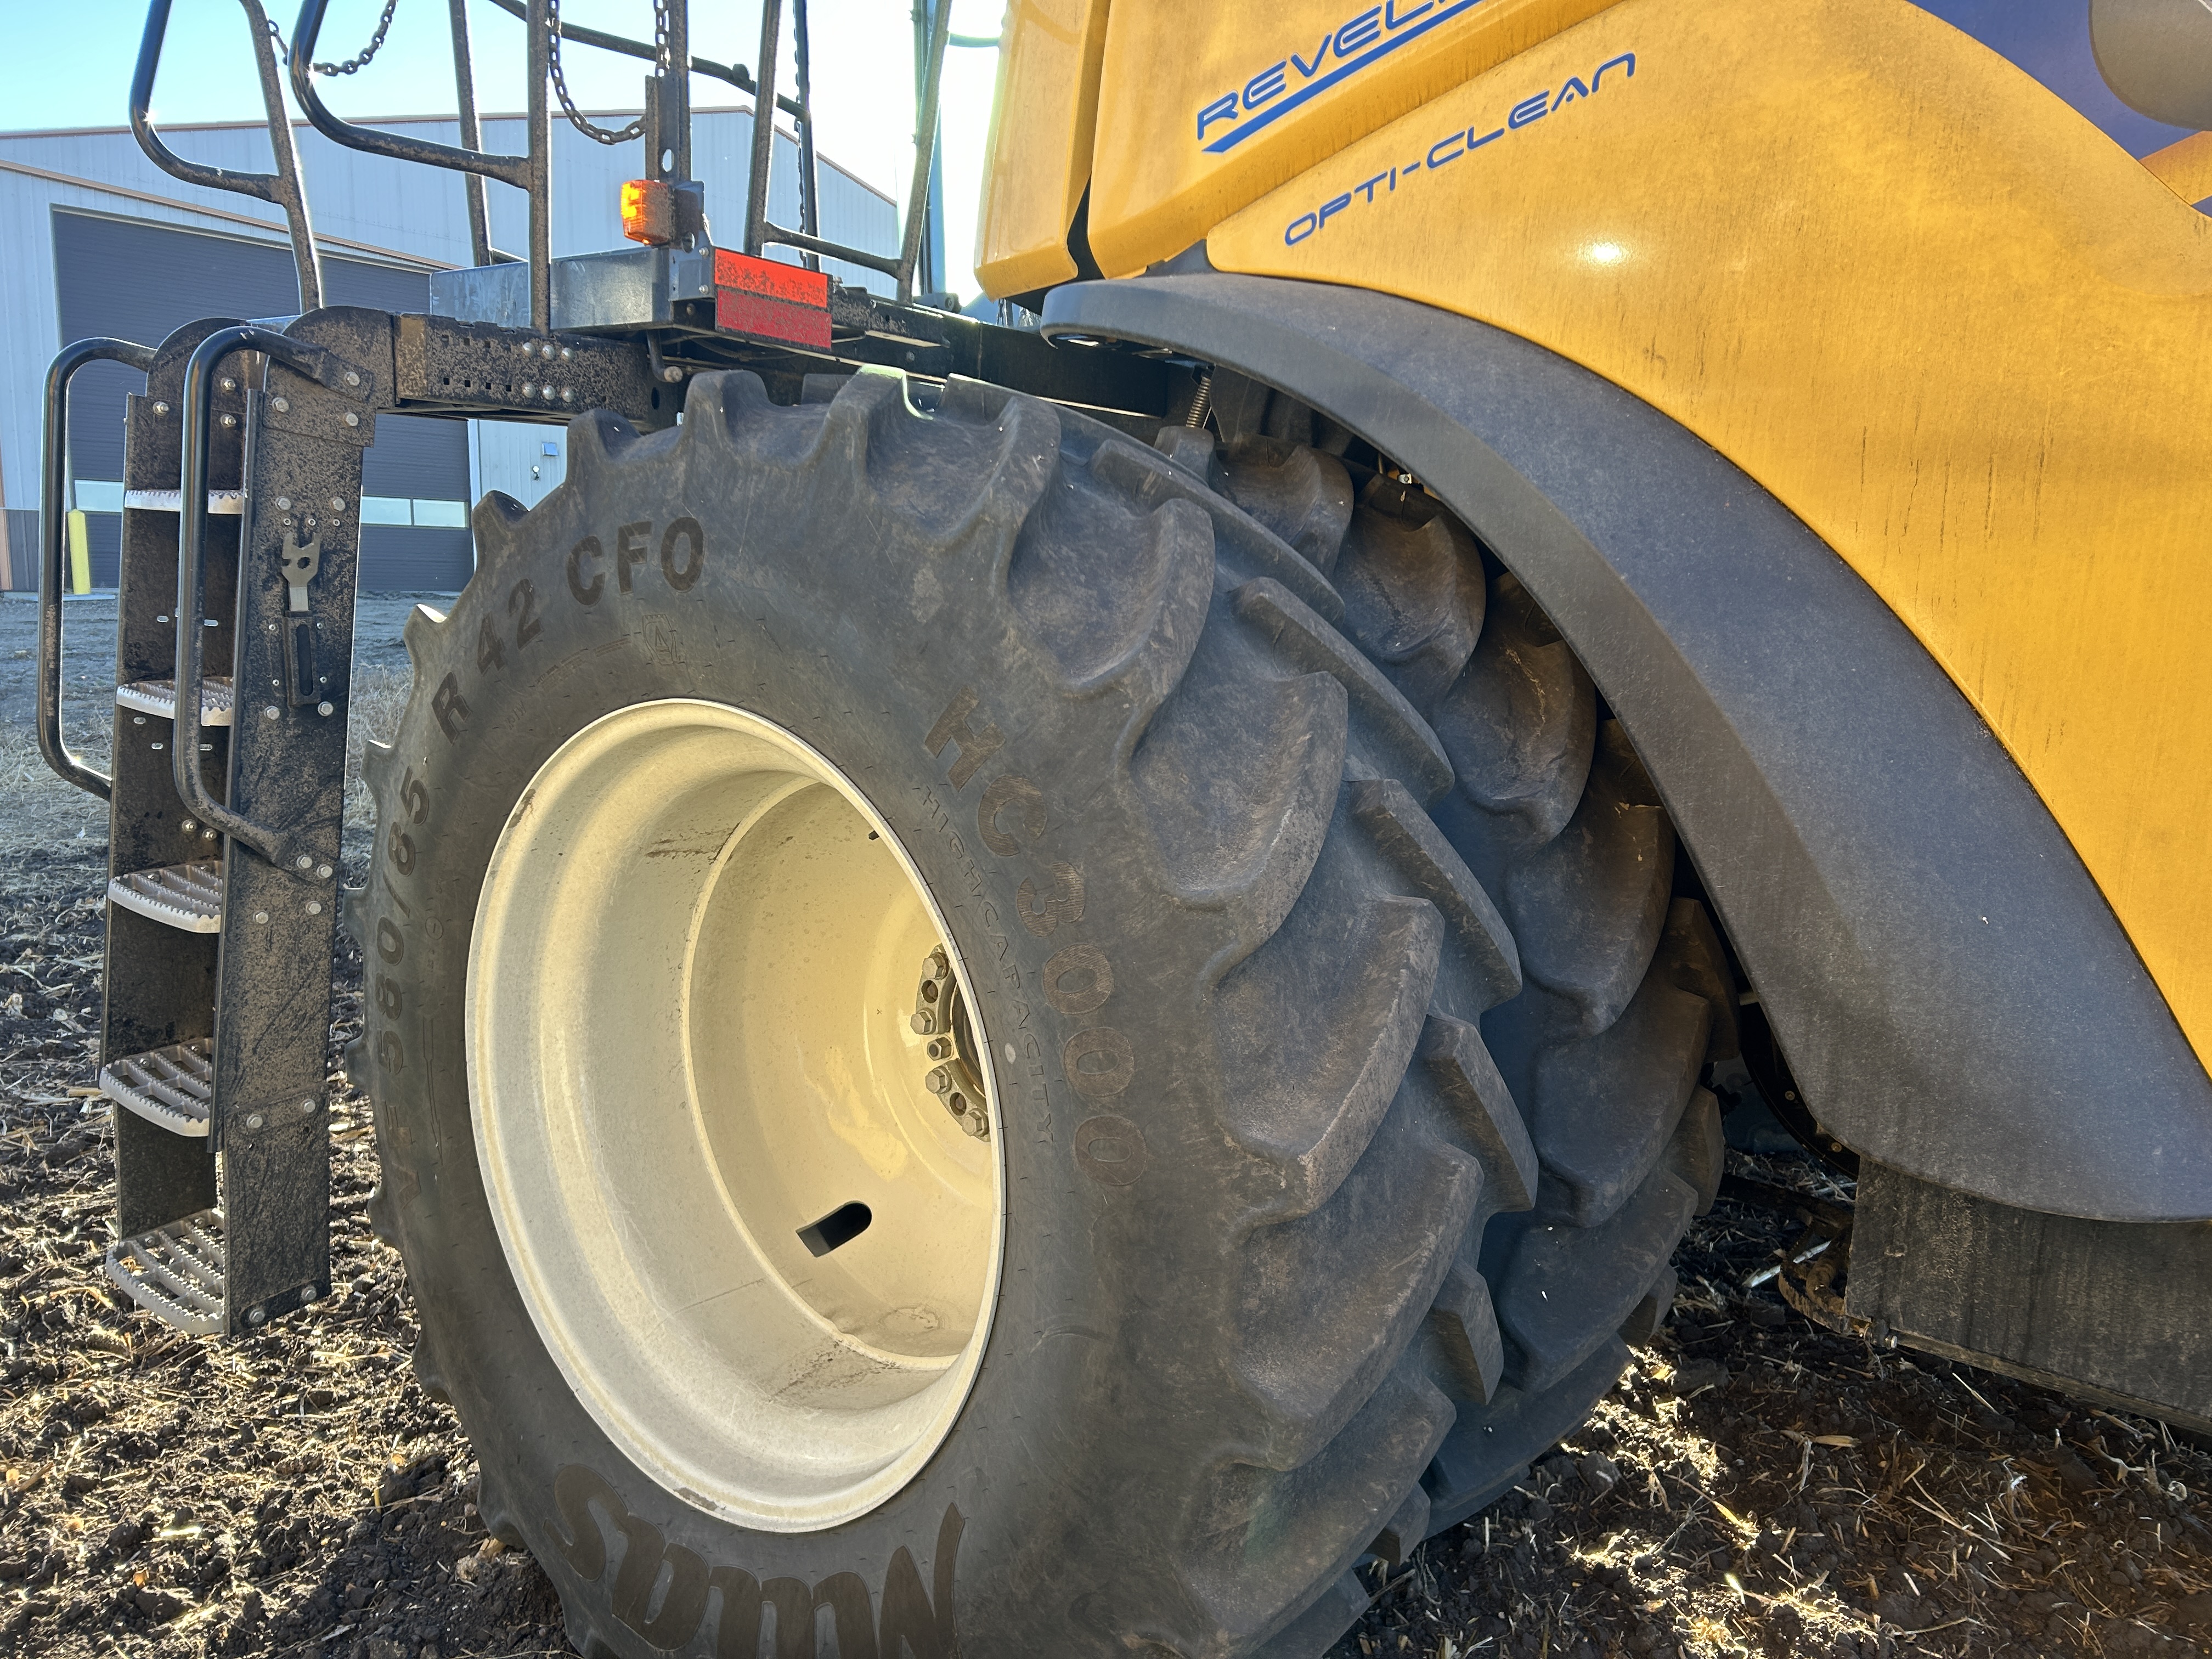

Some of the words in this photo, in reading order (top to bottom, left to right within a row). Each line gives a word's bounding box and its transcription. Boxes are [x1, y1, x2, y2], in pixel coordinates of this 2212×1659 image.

[1197, 0, 1445, 140] REVEL
[1285, 53, 1637, 246] OPTI-CLEAN
[375, 766, 430, 1074] 580/85
[431, 670, 471, 745] R
[478, 578, 543, 676] 42
[567, 517, 706, 607] CFO
[919, 785, 983, 894] HIGH
[980, 900, 1054, 1143] CAPACITY
